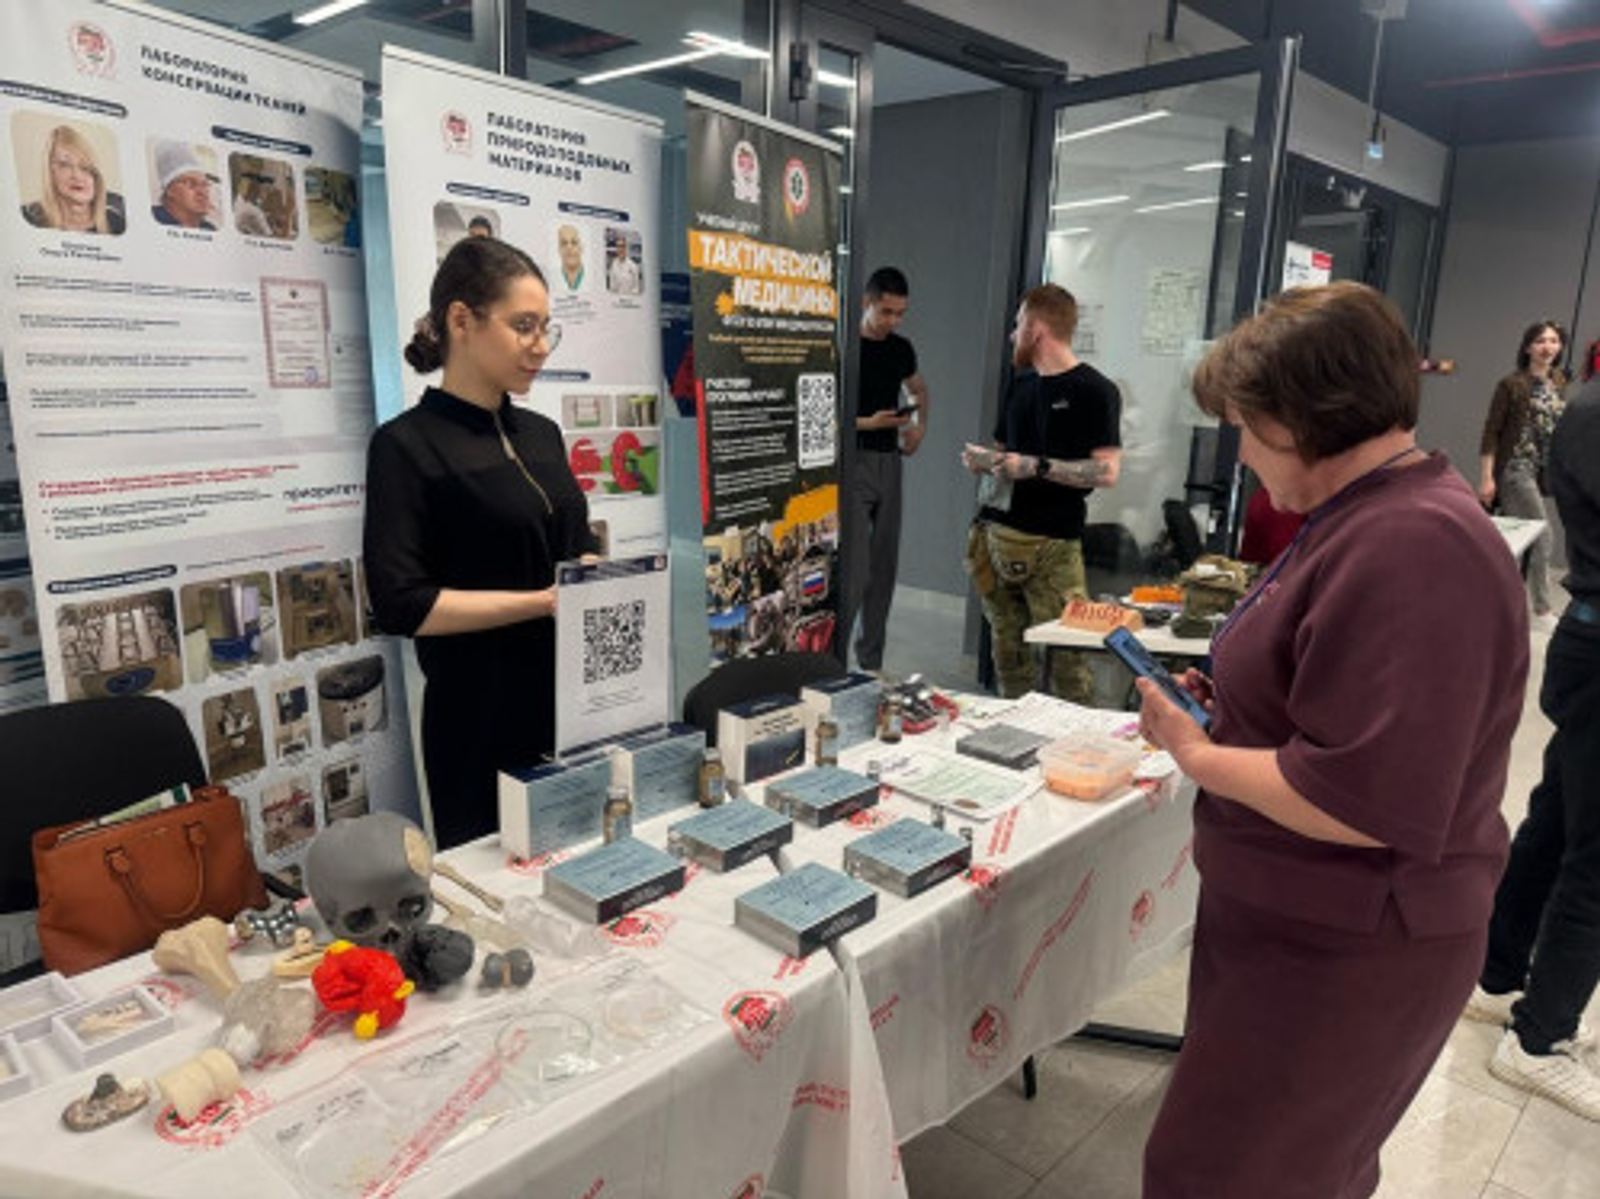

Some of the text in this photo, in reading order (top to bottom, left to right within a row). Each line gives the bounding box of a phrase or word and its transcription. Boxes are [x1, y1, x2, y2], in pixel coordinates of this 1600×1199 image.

[487, 112, 586, 146] ЛАБОРАТОРИЯ
[488, 152, 582, 182] МАТЕРИАЛОВ
[699, 234, 832, 283] ТАКТИЧЕСКОЙ
[733, 275, 836, 316] МЕДИЦИНЫ
